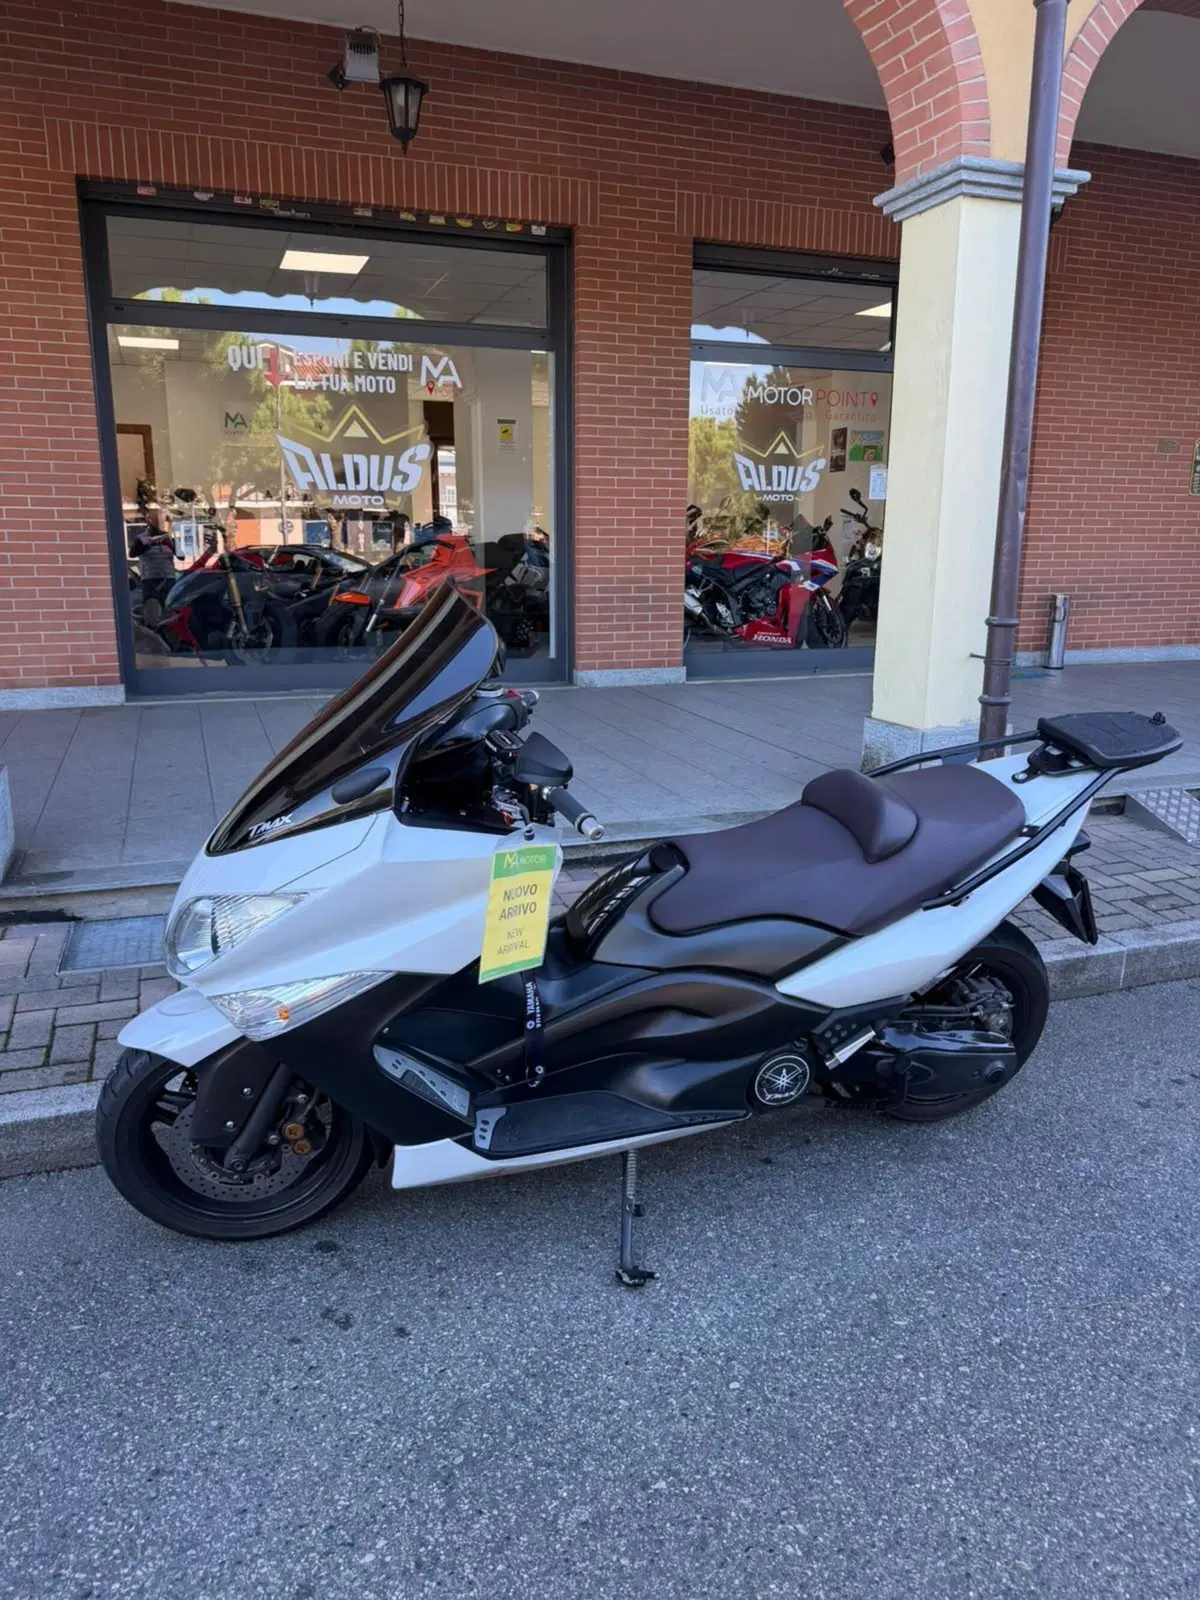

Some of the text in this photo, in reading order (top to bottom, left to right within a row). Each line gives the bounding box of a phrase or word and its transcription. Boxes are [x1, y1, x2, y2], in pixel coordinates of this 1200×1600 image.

[227, 345, 263, 371] QUI
[354, 352, 362, 369] E
[367, 353, 413, 372] VENDI
[294, 372, 396, 394] LA TUA MOTO
[747, 386, 870, 408] MOTOR POINT
[700, 405, 734, 417] Usato
[276, 433, 431, 492] ALDUS
[733, 452, 828, 492] ALDUS
[332, 495, 385, 506] MOTO
[763, 493, 795, 502] MOTO
[753, 634, 791, 644] HONDA
[502, 883, 538, 902] NUOVO
[498, 901, 538, 921] ARRIVO
[506, 926, 525, 940] NEW
[496, 940, 531, 956] ARRIVAL
